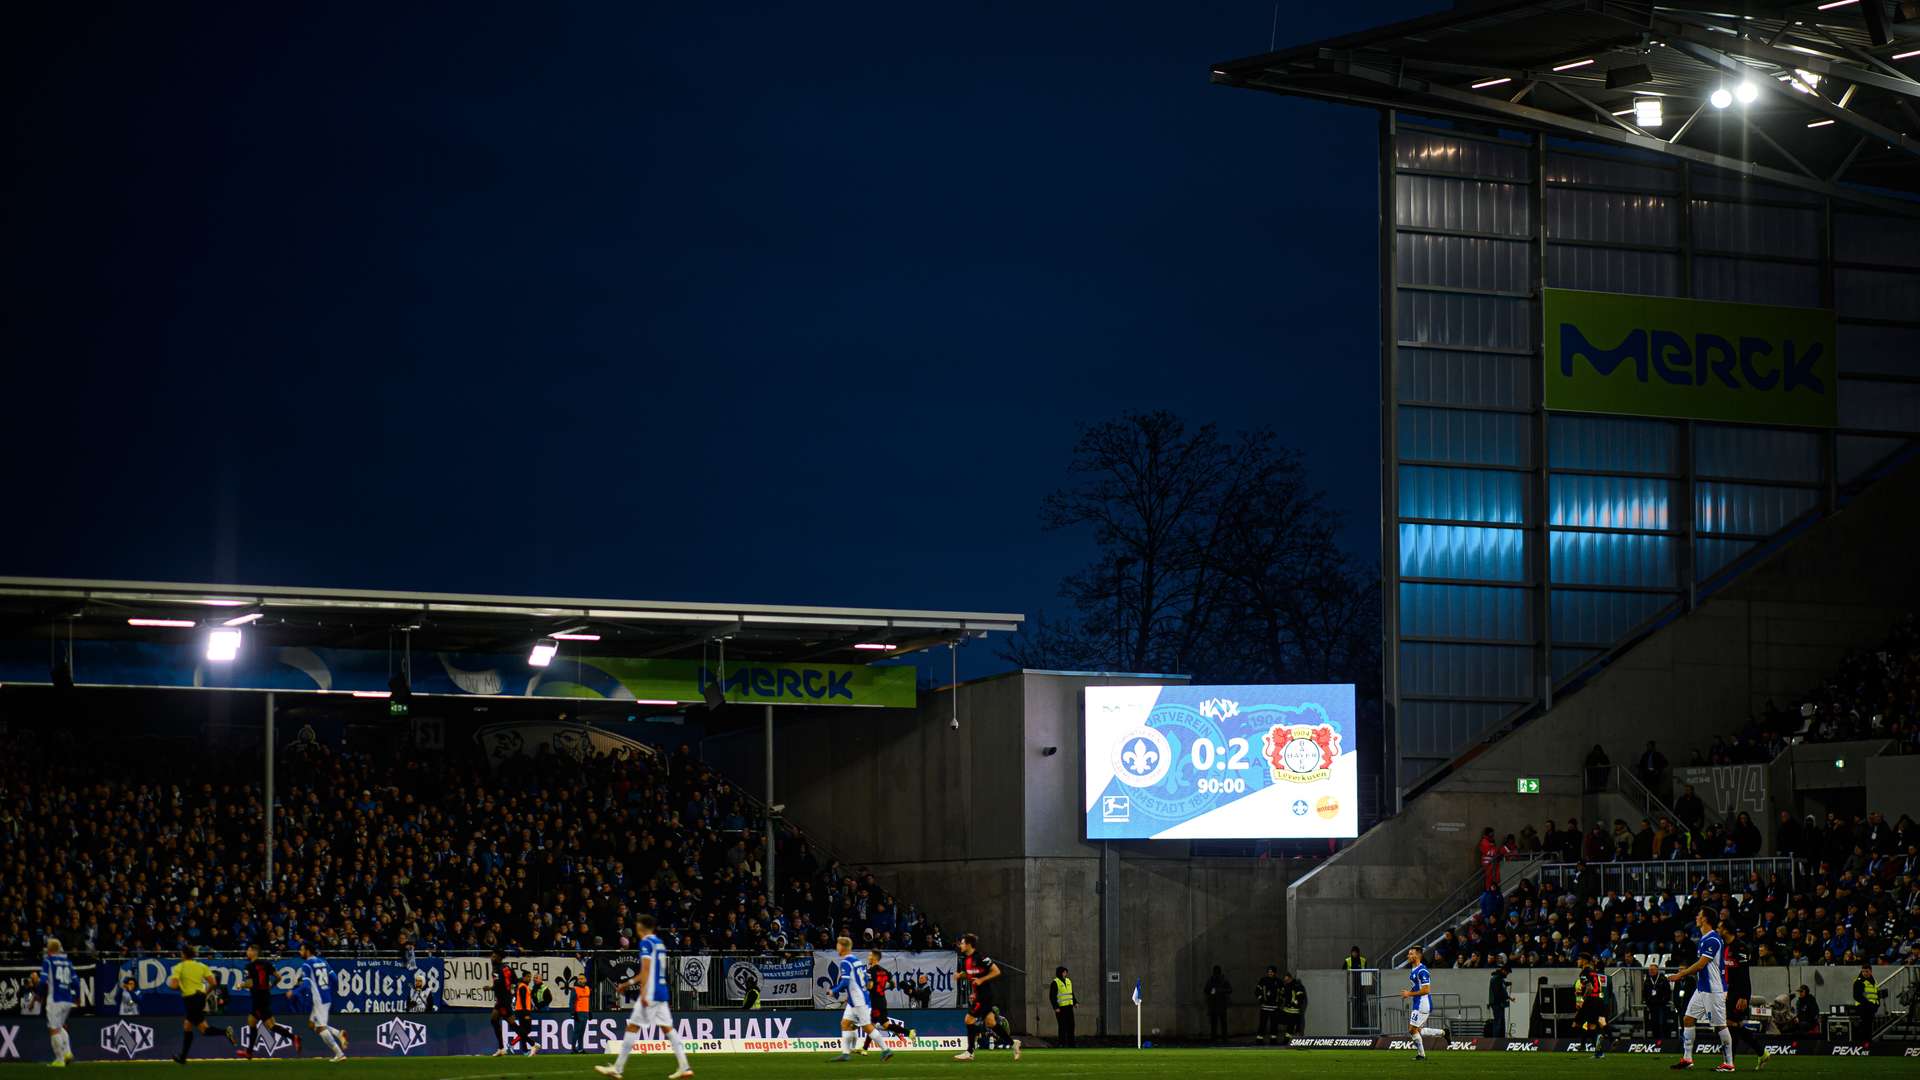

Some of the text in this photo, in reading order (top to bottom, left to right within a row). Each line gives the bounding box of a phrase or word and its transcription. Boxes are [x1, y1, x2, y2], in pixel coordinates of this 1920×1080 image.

[1191, 737, 1249, 770] 0:2
[1197, 777, 1246, 794] 90:00
[772, 983, 798, 995] 1978
[100, 1018, 154, 1059] HAIX
[376, 1015, 427, 1055] HAIX
[1290, 1039, 1373, 1047] SMART HOME STEUERUNG
[744, 1039, 842, 1054] magnet-shop.net
